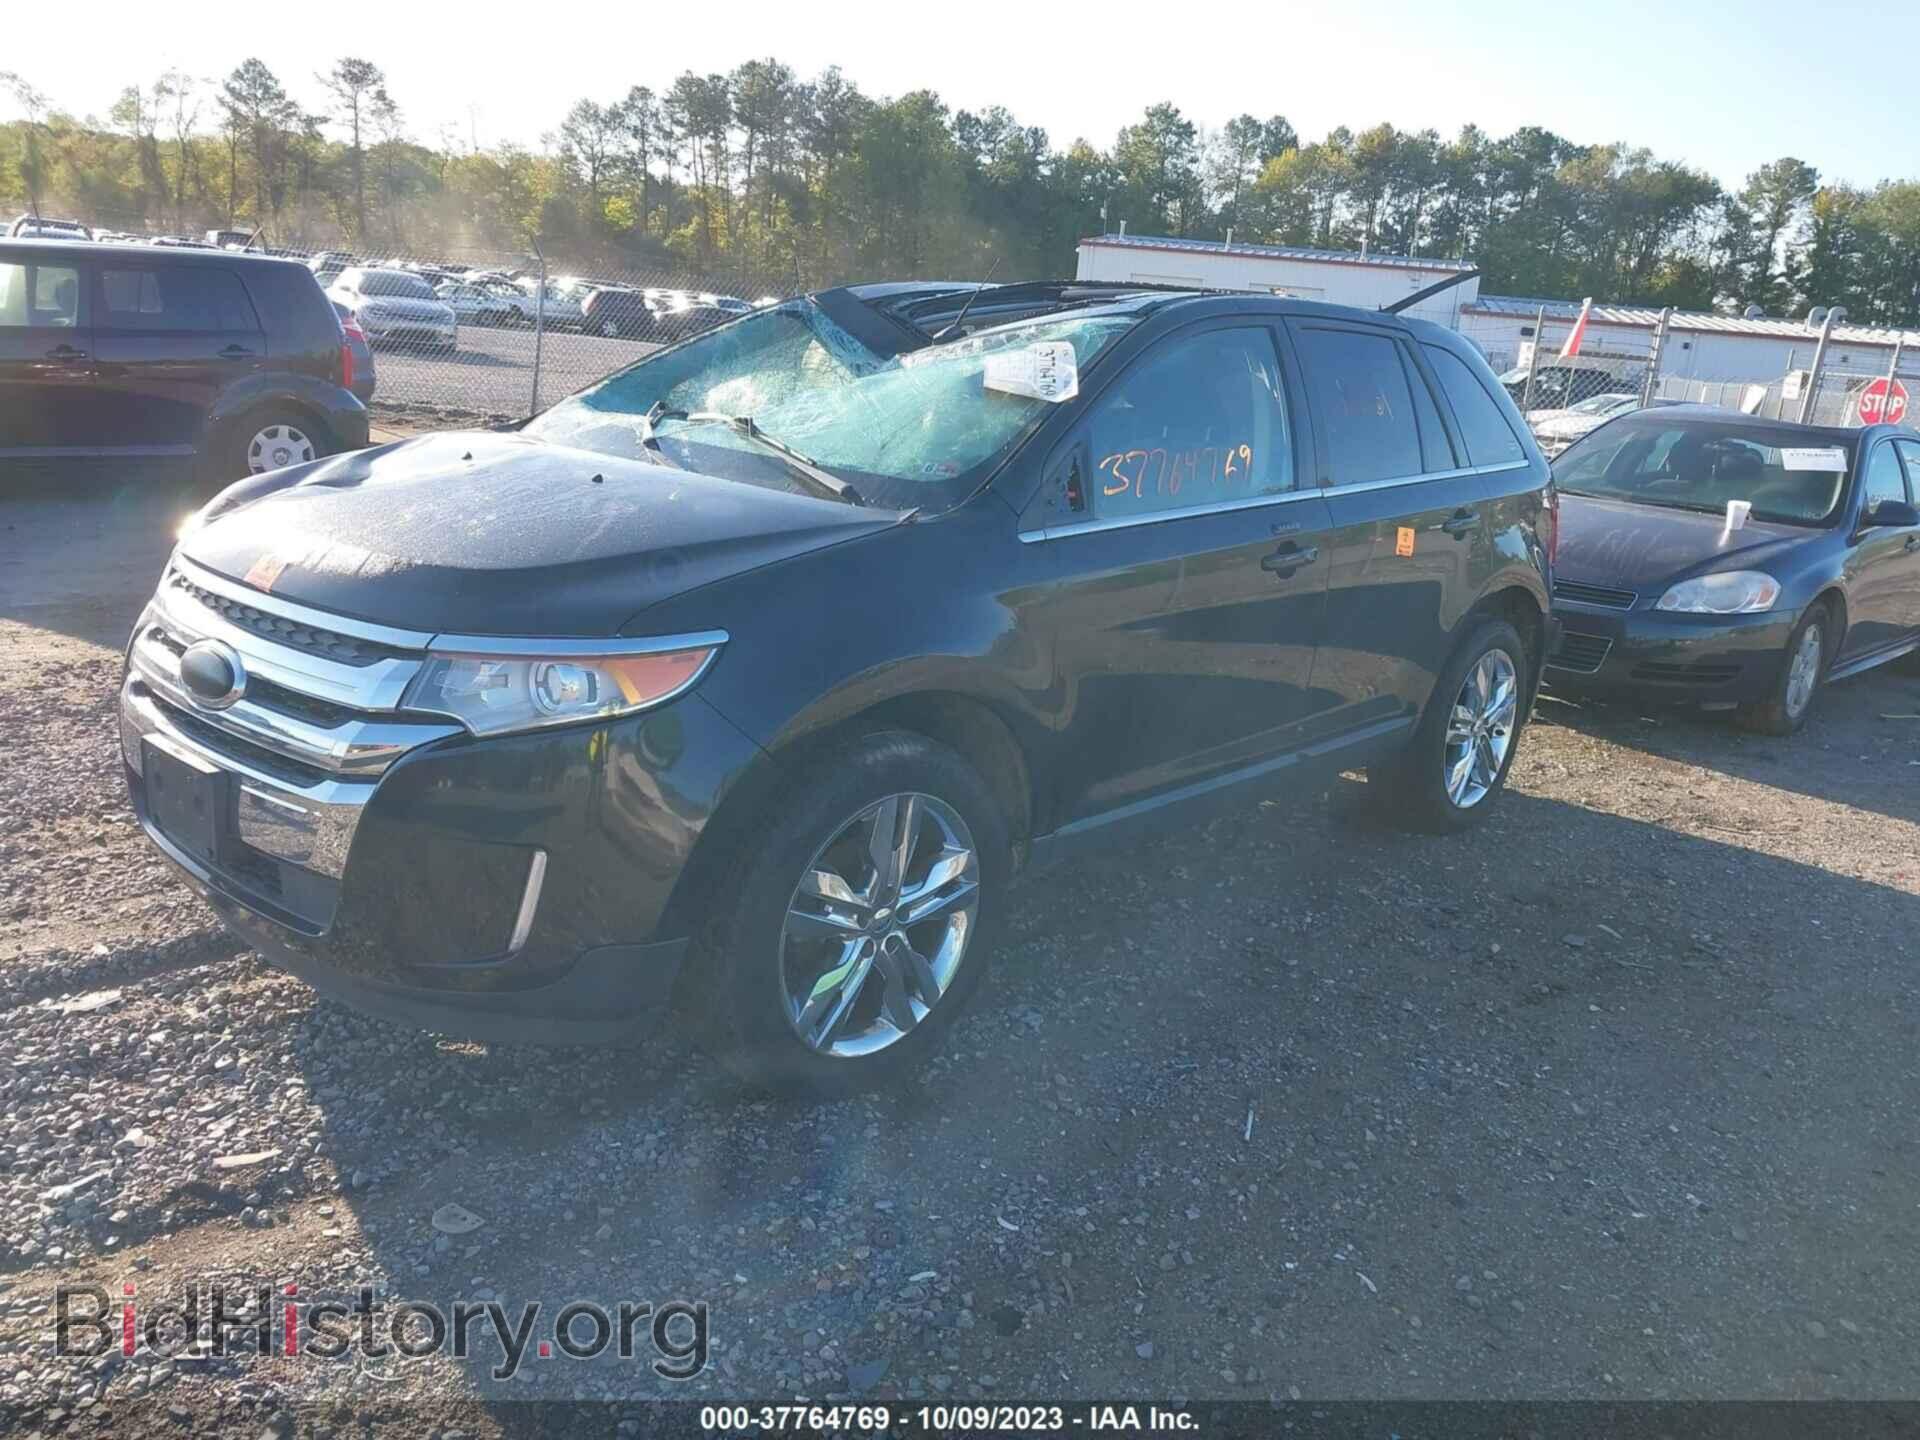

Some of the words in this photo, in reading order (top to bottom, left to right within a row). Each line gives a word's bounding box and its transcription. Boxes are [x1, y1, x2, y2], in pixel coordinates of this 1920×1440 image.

[1039, 349, 1057, 397] 37764769
[1861, 393, 1905, 415] STOP
[1099, 444, 1252, 498] 37764769
